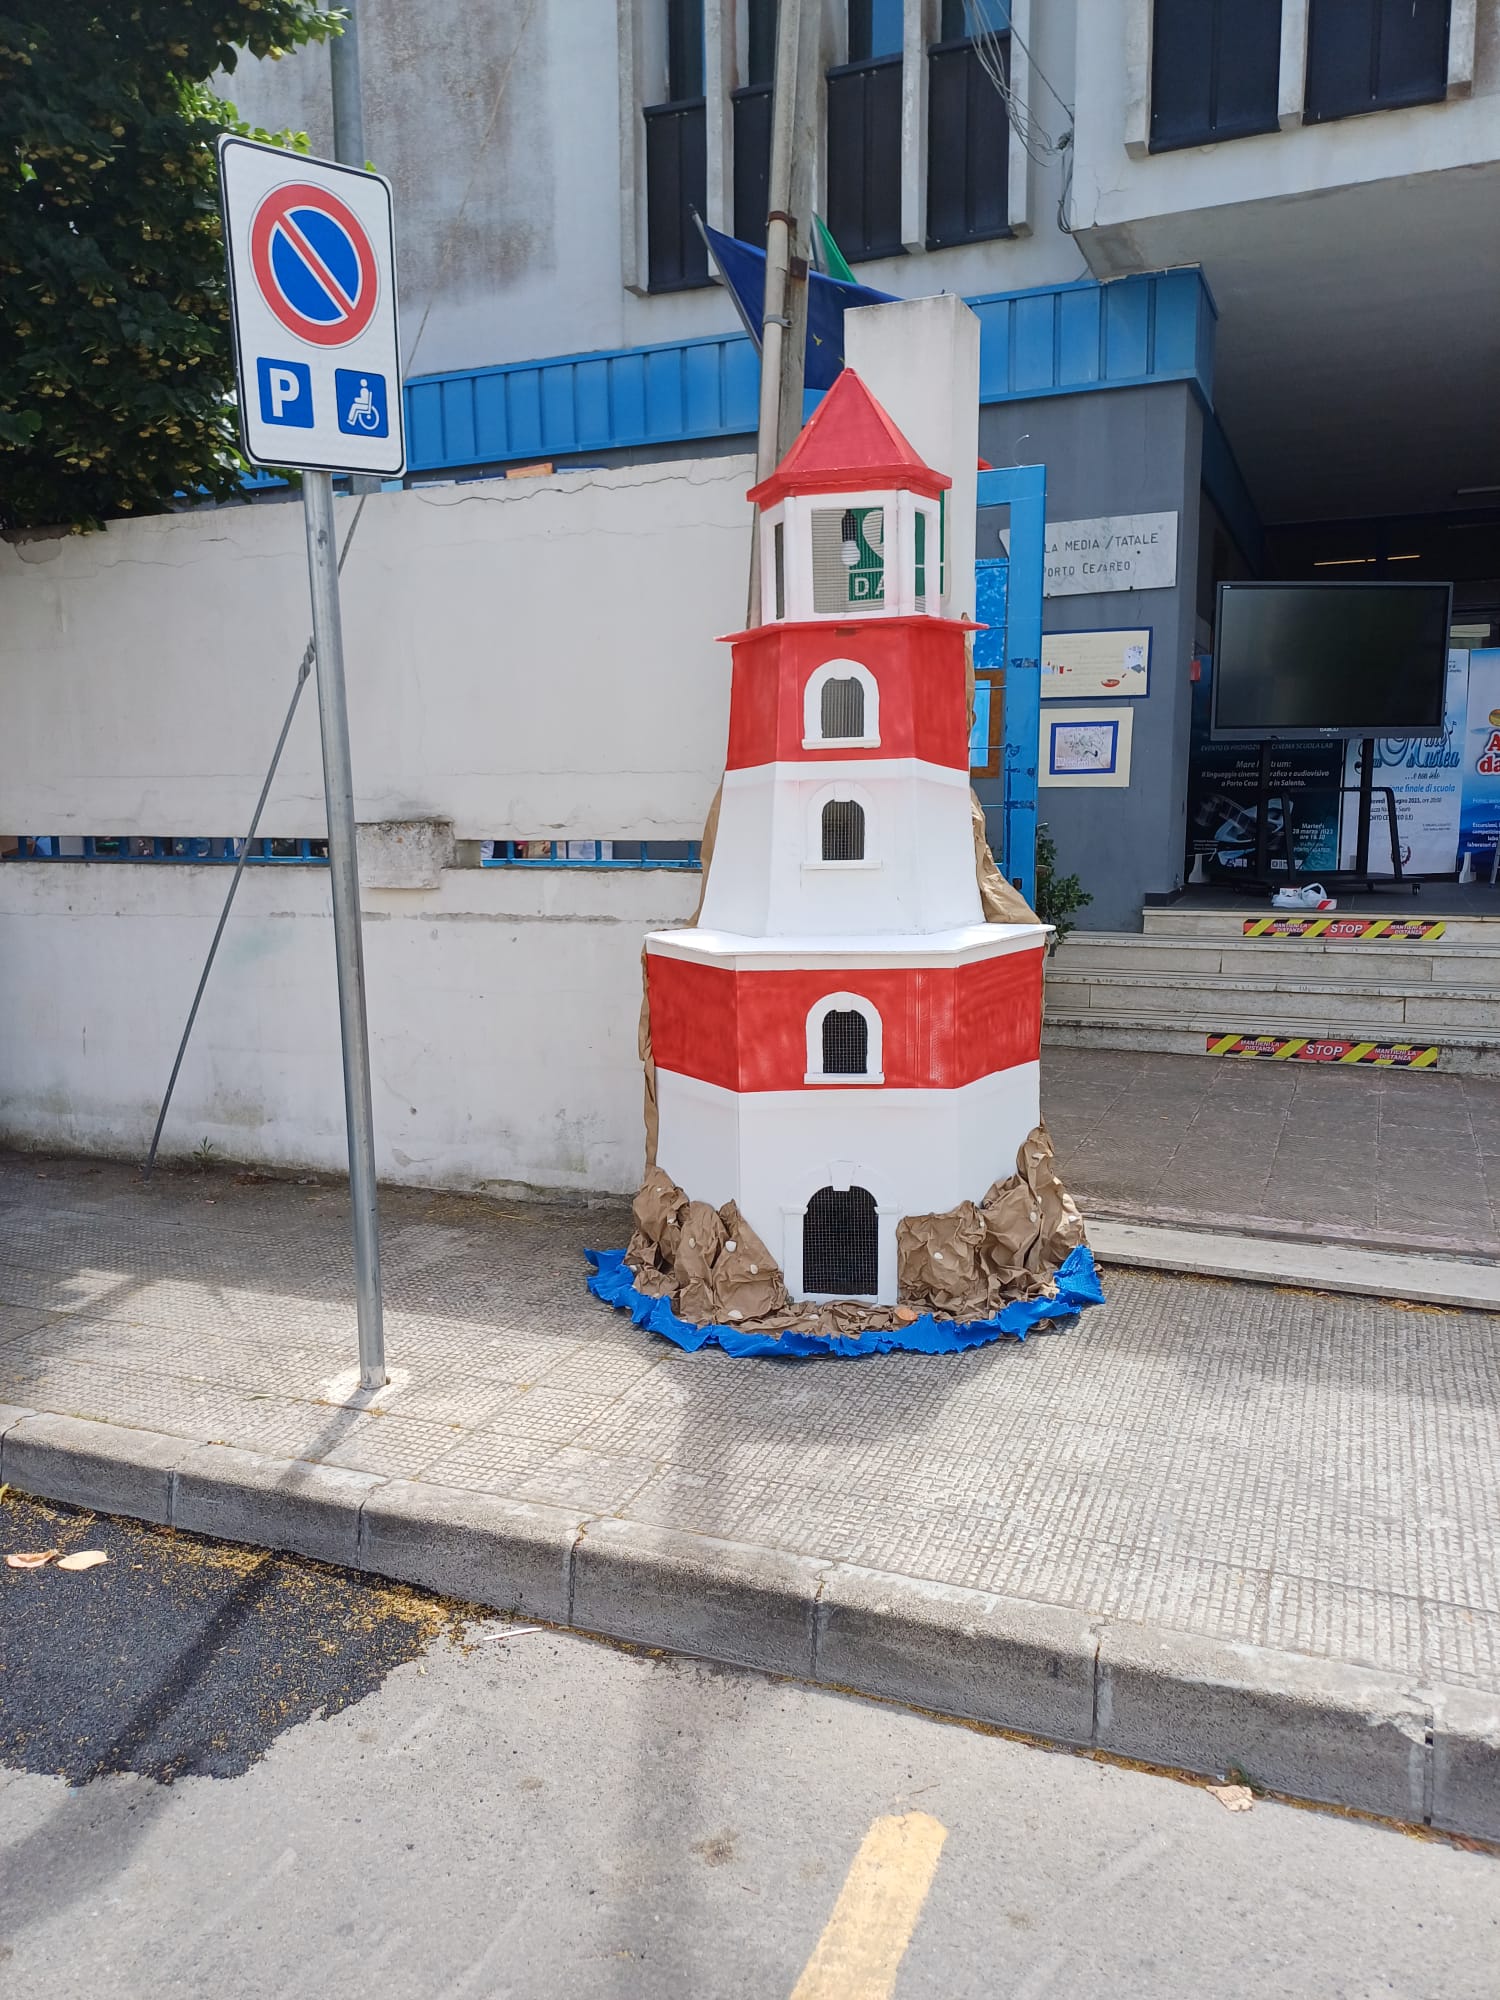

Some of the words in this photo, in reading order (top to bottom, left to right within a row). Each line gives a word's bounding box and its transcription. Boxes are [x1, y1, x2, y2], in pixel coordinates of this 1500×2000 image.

[269, 367, 301, 418] P
[1065, 539, 1100, 551] MEDIA
[1293, 769, 1330, 777] audiovisivo
[1405, 783, 1424, 793] finale
[1426, 783, 1433, 793] di
[1433, 784, 1455, 793] scuola
[1330, 923, 1363, 934] STOP
[1240, 1039, 1269, 1047] MANTIENI
[1244, 1045, 1276, 1053] DISTANZA
[1305, 1045, 1343, 1057] STOP
[1374, 1048, 1405, 1056] MANTIENI
